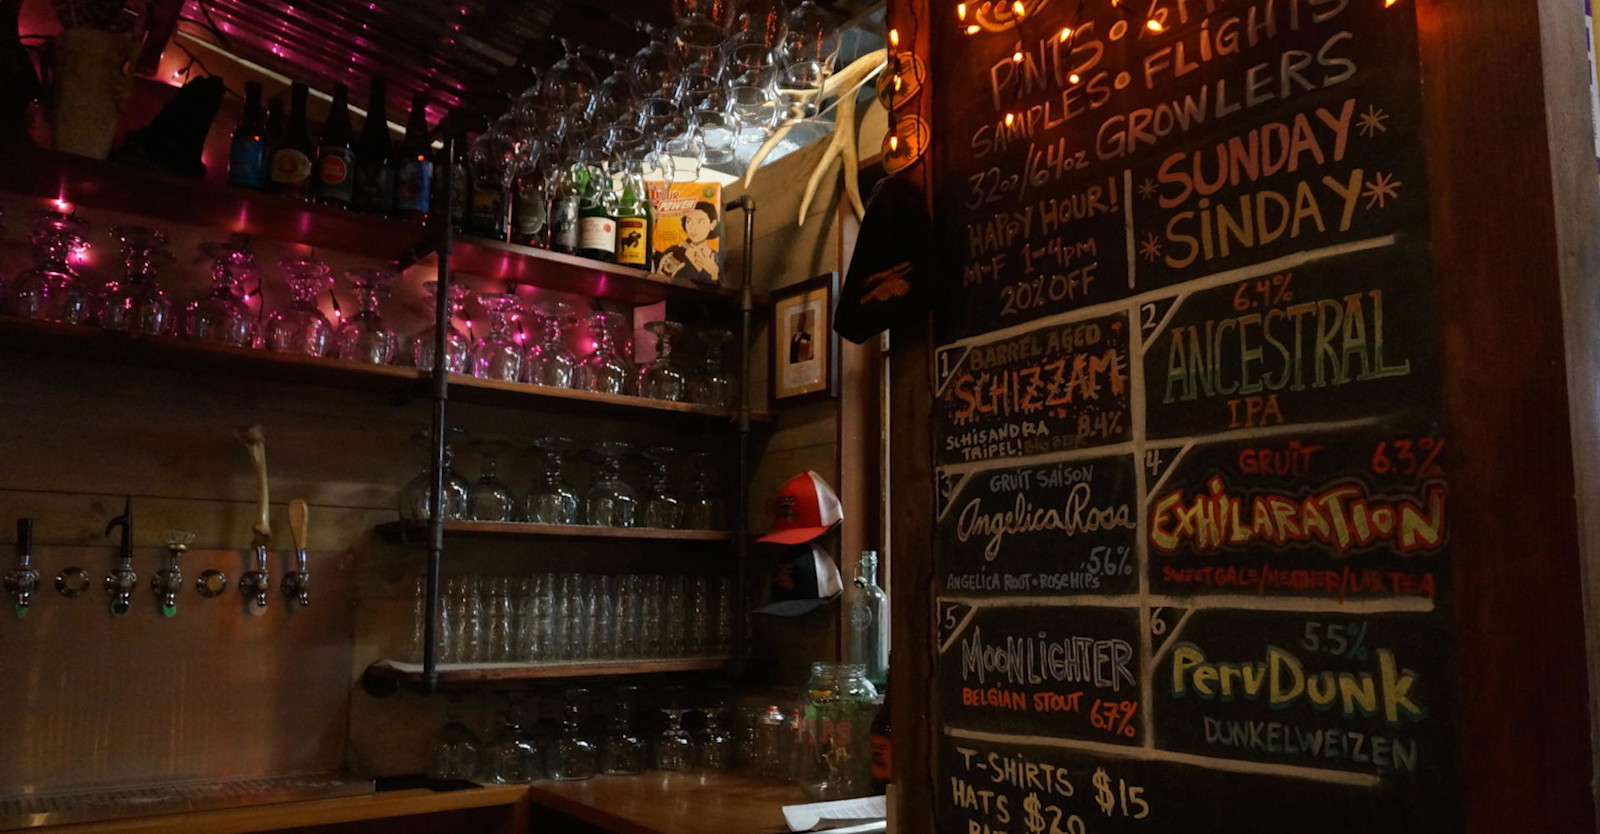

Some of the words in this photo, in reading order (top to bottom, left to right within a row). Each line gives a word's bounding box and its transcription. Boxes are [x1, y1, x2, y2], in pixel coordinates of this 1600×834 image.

[971, 71, 1111, 159] SAMPLES
[1095, 32, 1357, 161] GROWLERS
[1157, 98, 1357, 209] SUNDAY
[967, 206, 1033, 258] HAPPY
[1039, 176, 1120, 236] HOUR!
[963, 253, 1007, 288] M-F
[1000, 274, 1046, 317] 20%
[1048, 261, 1099, 302] OFF
[1233, 273, 1294, 311] 6.4%
[1141, 303, 1157, 329] 2
[940, 351, 949, 378] 1
[969, 334, 1042, 371] BARREL
[1044, 323, 1101, 355] AGED
[1162, 289, 1411, 405] ANCESTRAL
[953, 348, 1127, 424] SCHIZZAM
[1077, 411, 1123, 439] 8.4%
[1226, 394, 1285, 429] IPA
[1146, 449, 1163, 477] 4
[1372, 437, 1447, 475] 6.3%
[957, 492, 1064, 562] Angelica
[1064, 482, 1136, 537] Rosa
[1149, 473, 1447, 554] EXHILARATION
[1004, 573, 1031, 591] ROOT
[1389, 572, 1435, 600] TEA
[944, 605, 959, 630] 5
[1150, 607, 1166, 635] 6
[1300, 620, 1368, 661] 5.5%
[1033, 691, 1085, 712] STOUT
[1203, 716, 1418, 772] DUNKELWEIZEN
[951, 776, 1011, 824] HATS
[1022, 791, 1086, 834] $20
[1092, 766, 1151, 820] $15
